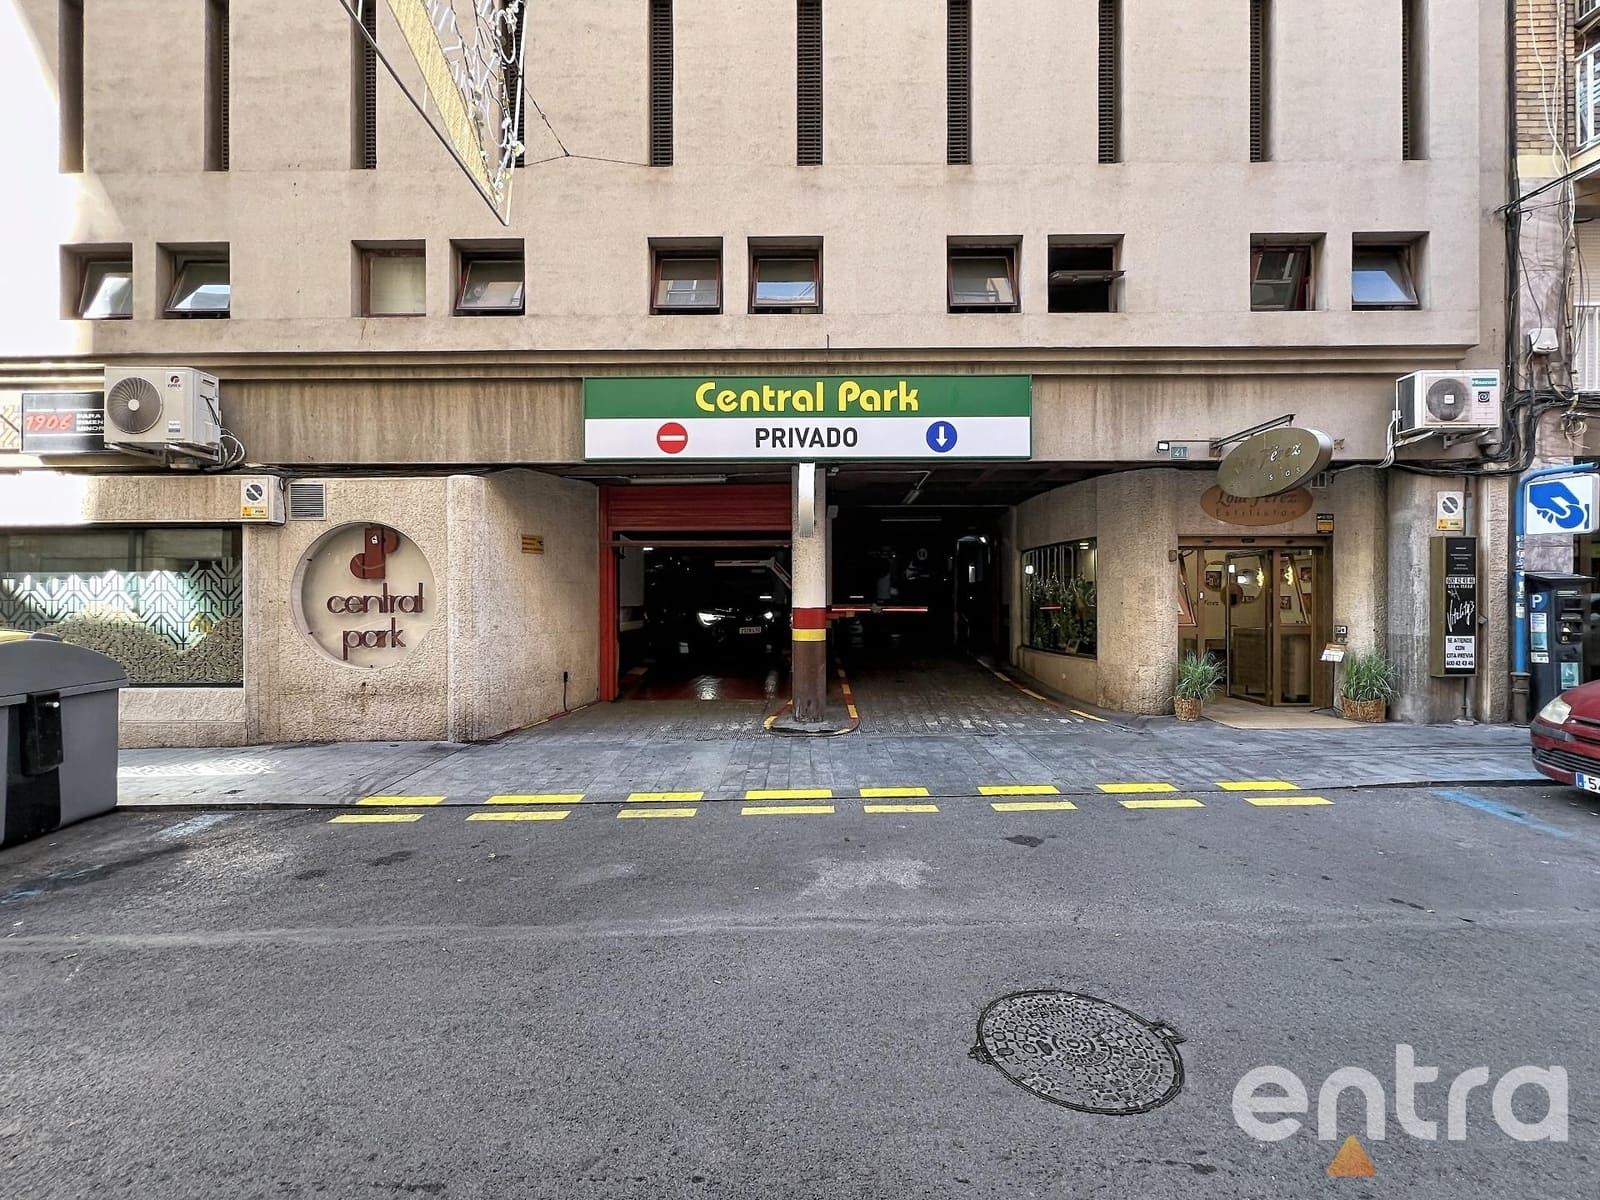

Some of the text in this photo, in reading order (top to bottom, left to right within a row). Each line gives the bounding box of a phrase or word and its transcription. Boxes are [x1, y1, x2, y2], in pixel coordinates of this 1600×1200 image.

[695, 380, 920, 412] Central Park
[26, 412, 73, 431] 1906
[755, 427, 858, 448] PRIVADO
[326, 582, 424, 614] central
[1532, 594, 1542, 609] P
[342, 617, 406, 660] park
[1588, 777, 1600, 791] 5
